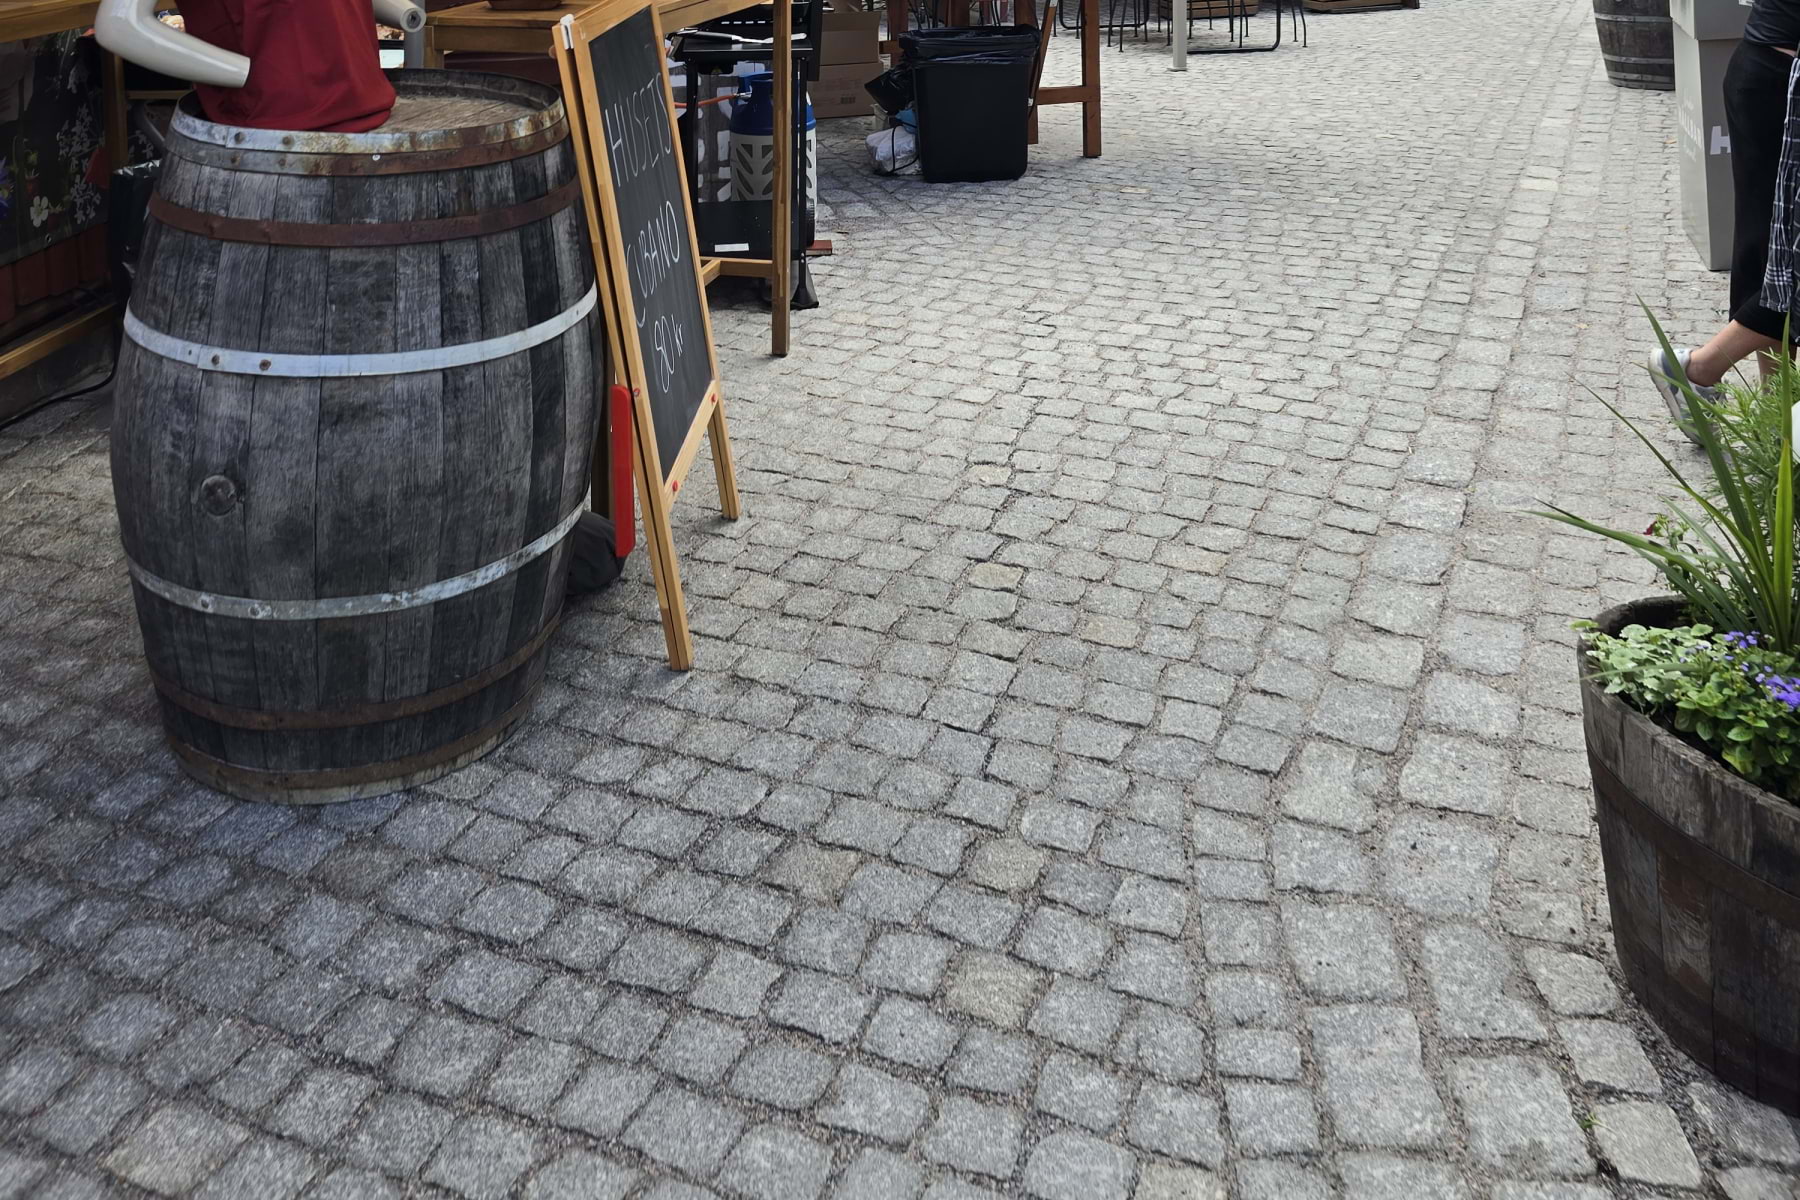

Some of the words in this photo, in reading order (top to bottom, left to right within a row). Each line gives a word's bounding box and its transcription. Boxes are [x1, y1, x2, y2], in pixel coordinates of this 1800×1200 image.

[604, 71, 672, 188] HUSETS
[626, 200, 680, 329] CUBANO
[654, 315, 675, 393] 80
